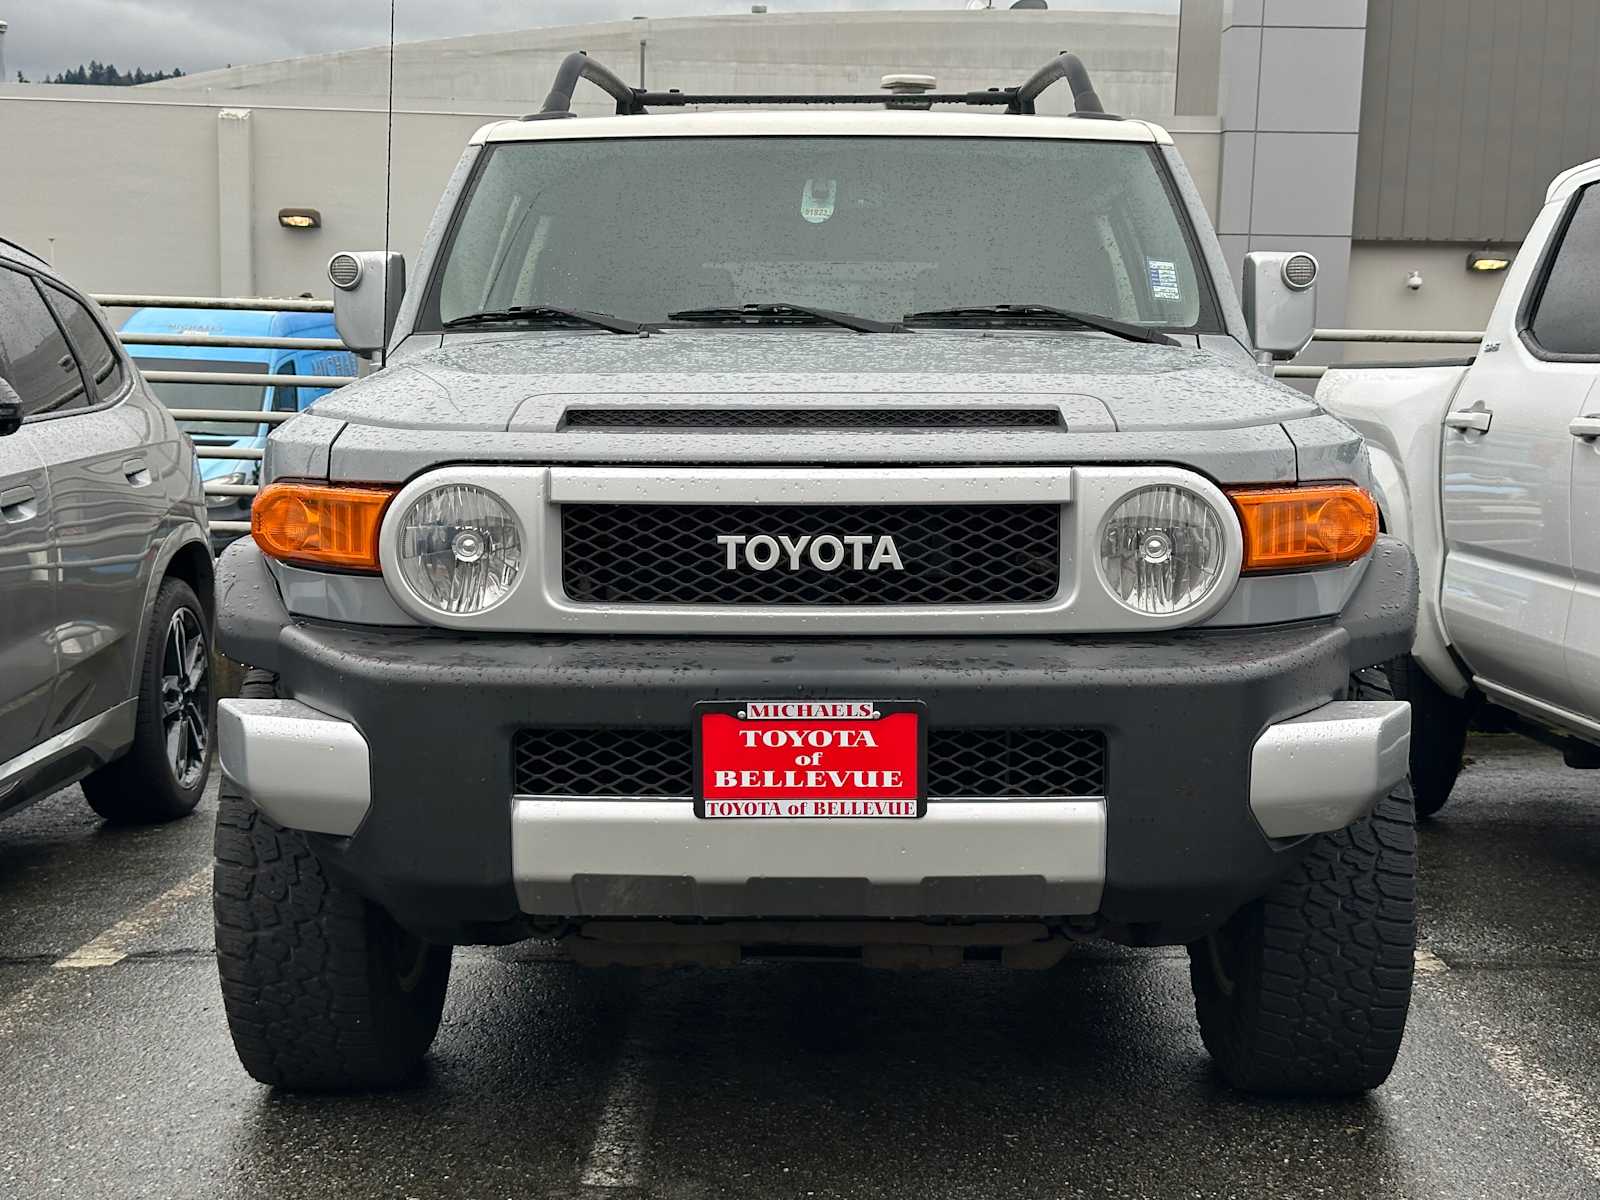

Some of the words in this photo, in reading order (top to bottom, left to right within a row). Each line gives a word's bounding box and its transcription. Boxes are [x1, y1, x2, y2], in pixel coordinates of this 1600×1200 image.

[716, 534, 904, 571] TOYOTA
[750, 704, 871, 717] MICHAELS
[739, 730, 878, 747] TOYOTA
[794, 752, 823, 766] of
[714, 770, 903, 787] BELLEVUE
[706, 802, 781, 816] TOYOTA
[788, 802, 807, 816] of
[813, 802, 915, 816] BELLEVUE
